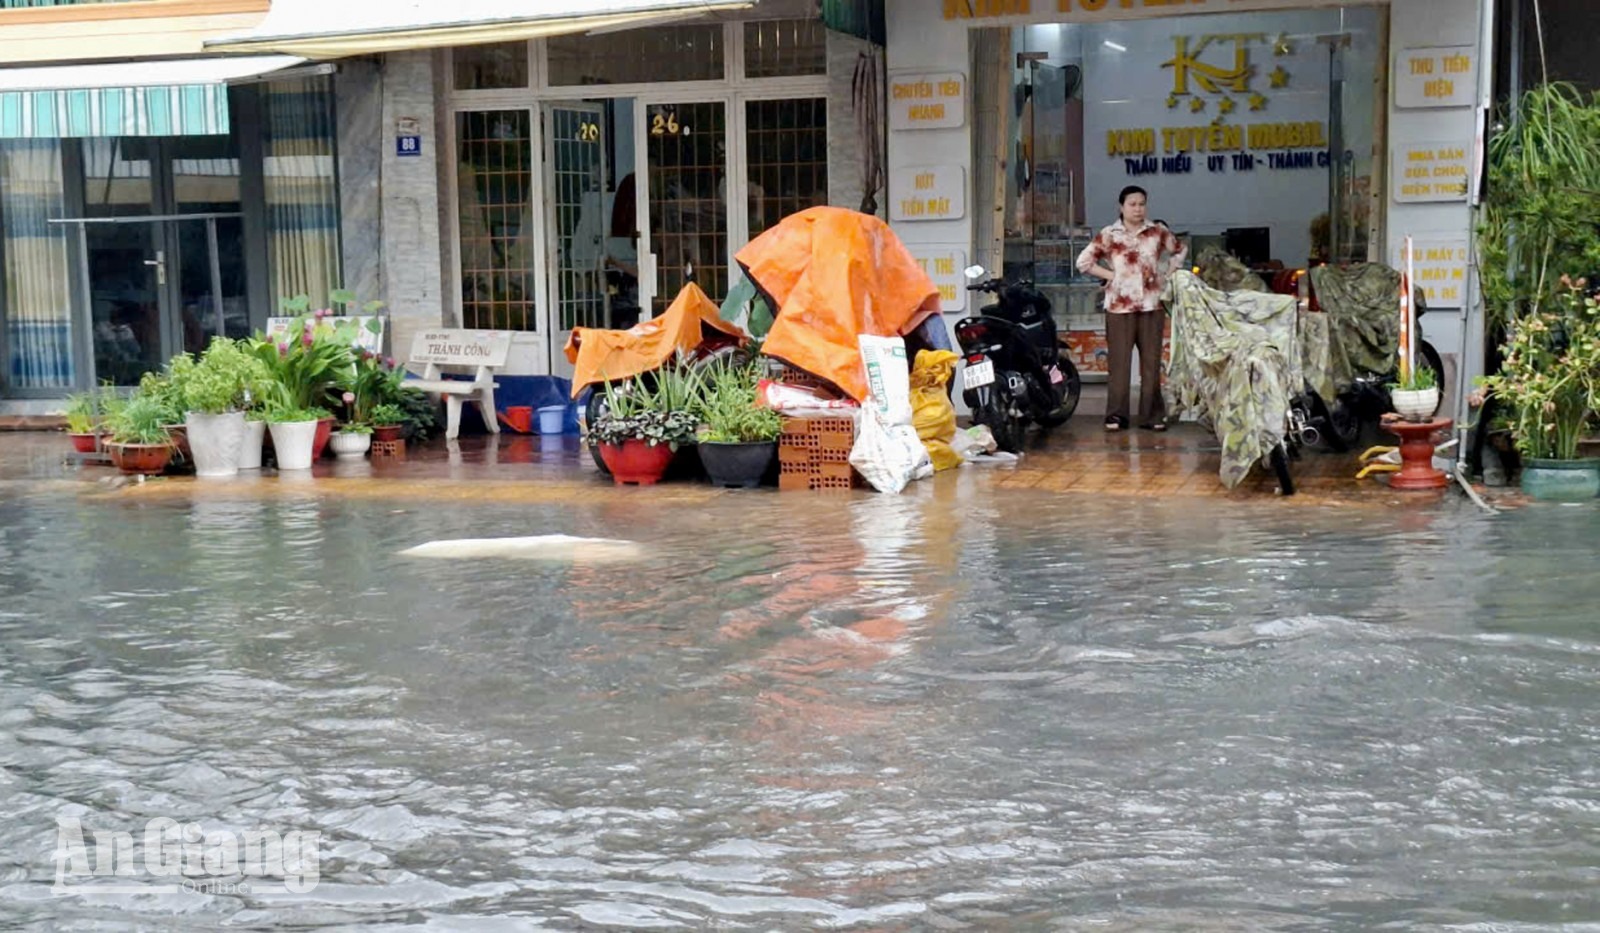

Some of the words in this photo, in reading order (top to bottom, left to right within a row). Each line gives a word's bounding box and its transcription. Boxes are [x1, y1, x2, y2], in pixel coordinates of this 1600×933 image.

[1409, 57, 1434, 75] THU
[652, 112, 679, 134] 26
[402, 138, 415, 150] 88
[1107, 128, 1155, 156] KIM
[1208, 155, 1224, 171] UY
